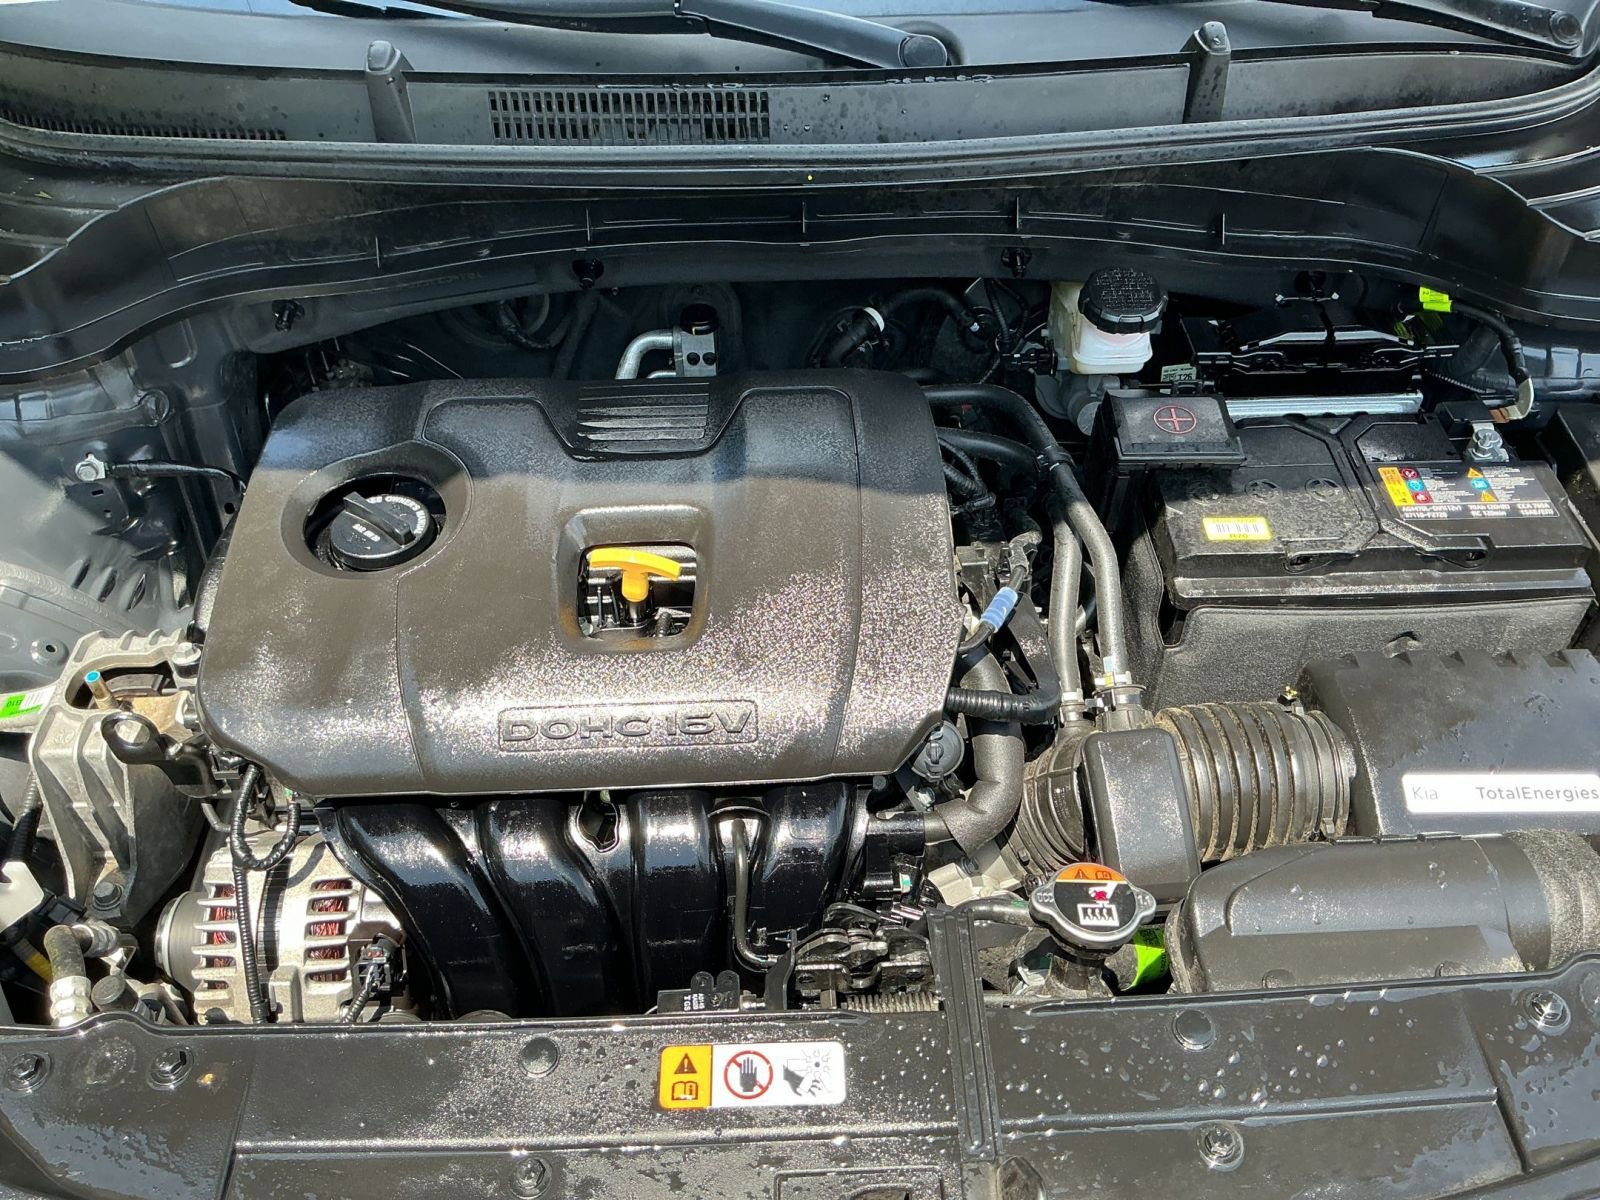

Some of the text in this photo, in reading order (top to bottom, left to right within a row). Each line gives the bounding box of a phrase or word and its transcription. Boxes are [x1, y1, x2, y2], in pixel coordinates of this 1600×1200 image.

[502, 710, 753, 742] DOHC 16V
[1411, 785, 1600, 802] Kia TotalEnergies
